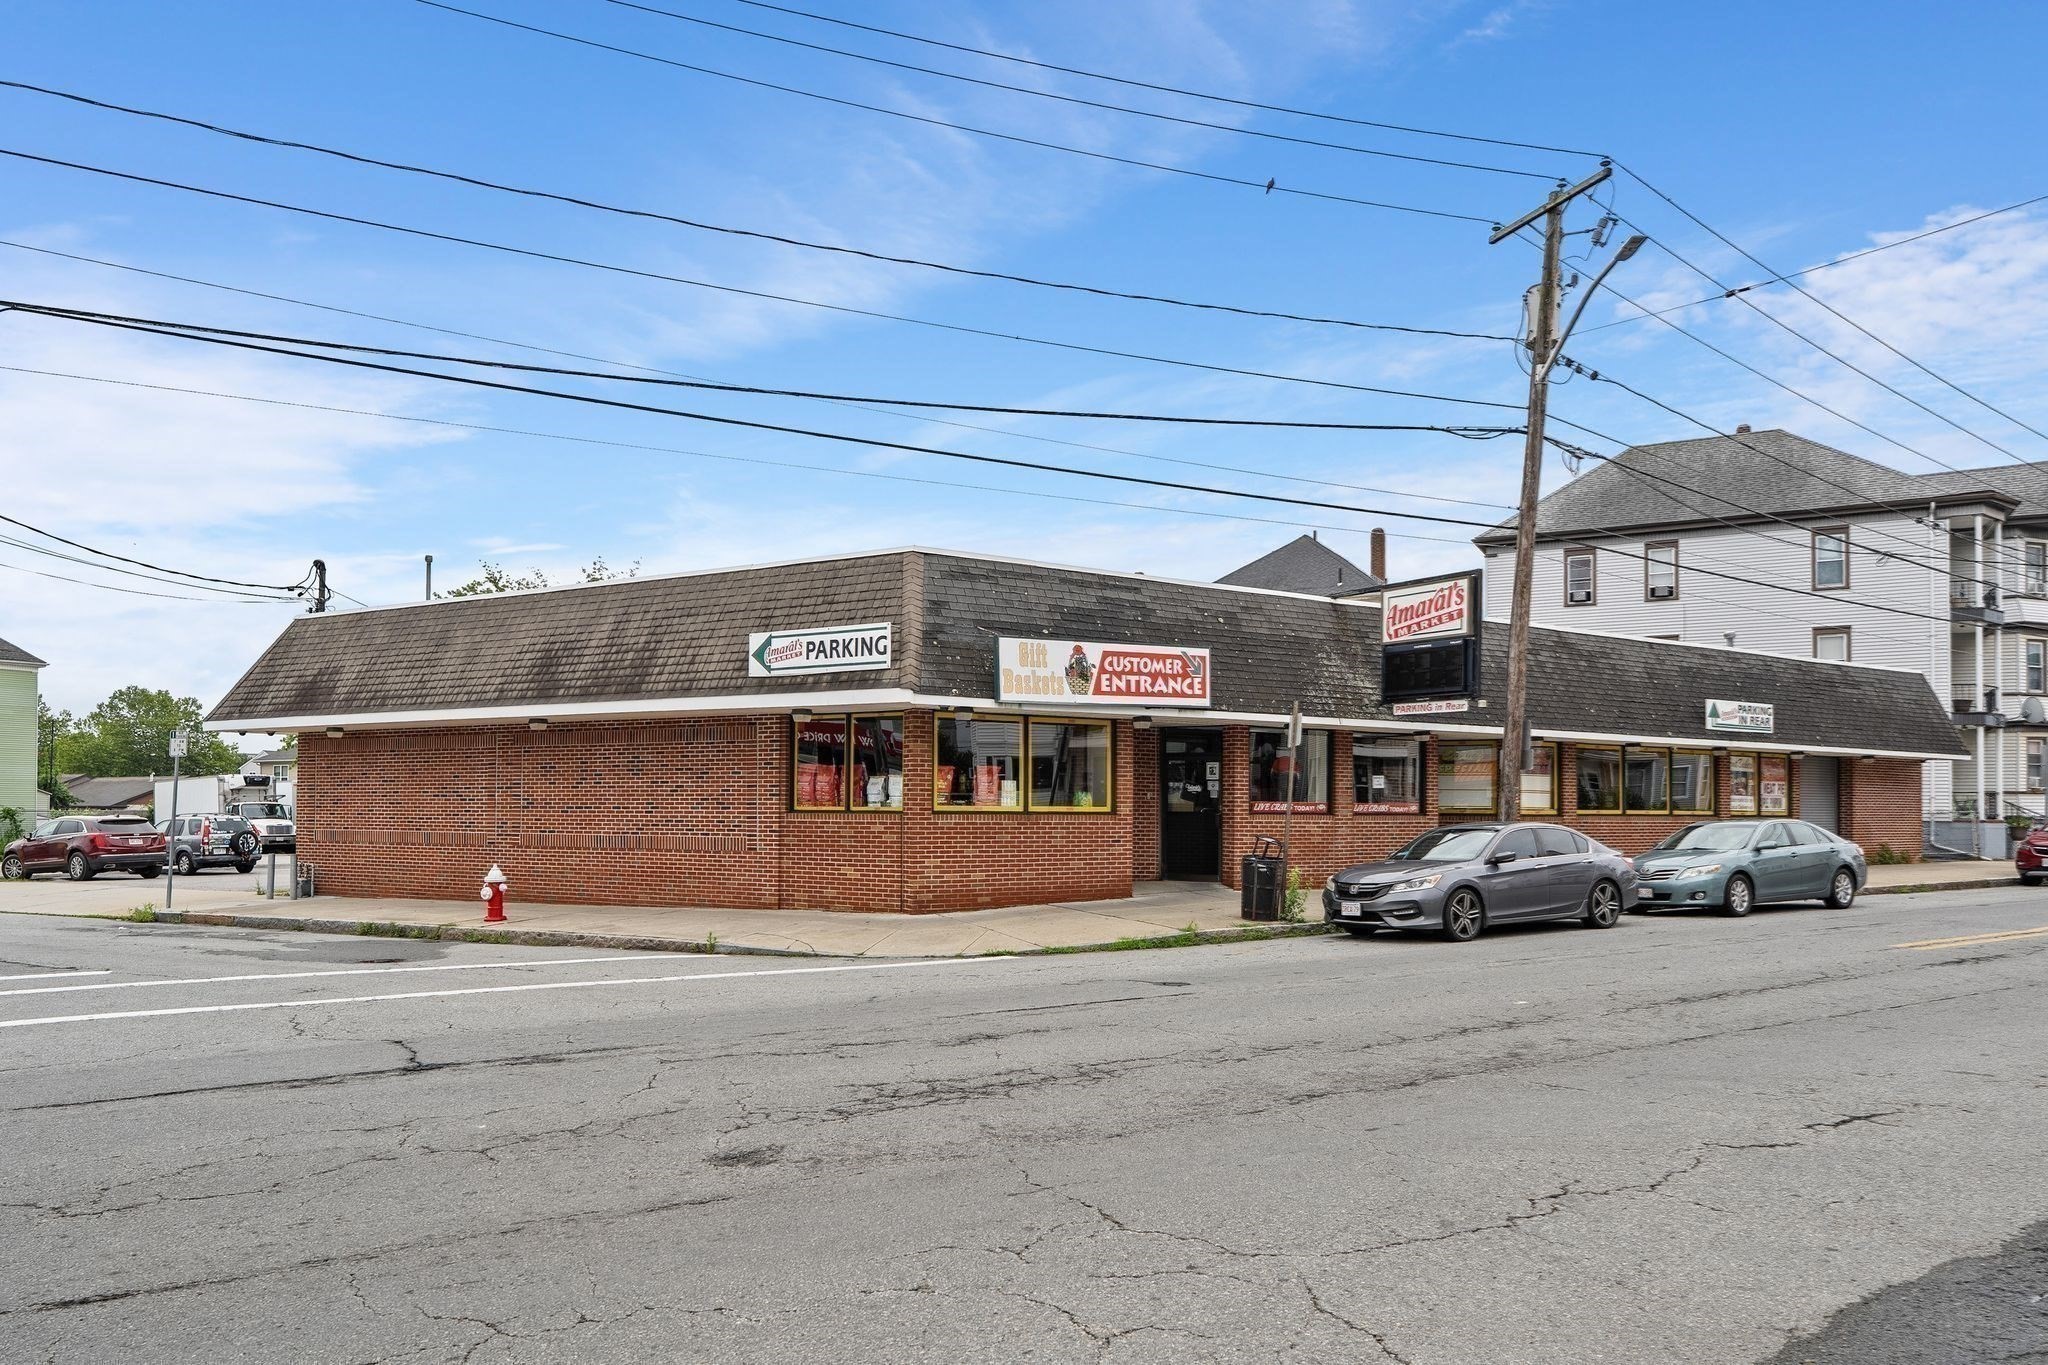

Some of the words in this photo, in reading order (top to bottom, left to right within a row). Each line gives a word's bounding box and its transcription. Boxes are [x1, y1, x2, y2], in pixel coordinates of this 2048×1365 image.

[1386, 582, 1464, 632] Amaral's
[1397, 612, 1459, 636] MARKET
[766, 638, 803, 660] Amaral's
[771, 652, 801, 663] MARKET
[805, 635, 888, 660] PARKING
[1018, 641, 1048, 668] Gift
[1103, 655, 1183, 674] CUSTOMER
[1002, 668, 1065, 695] Baskets
[1100, 674, 1203, 695] ENTRANCE
[1395, 703, 1432, 713] PARKING
[1434, 703, 1443, 711] in
[1444, 702, 1466, 711] Rear
[1737, 704, 1772, 716] PARKING
[1738, 715, 1748, 725] IN
[1749, 716, 1771, 727] REAR
[1253, 803, 1270, 811] LIVE
[1353, 804, 1369, 812] LIVE
